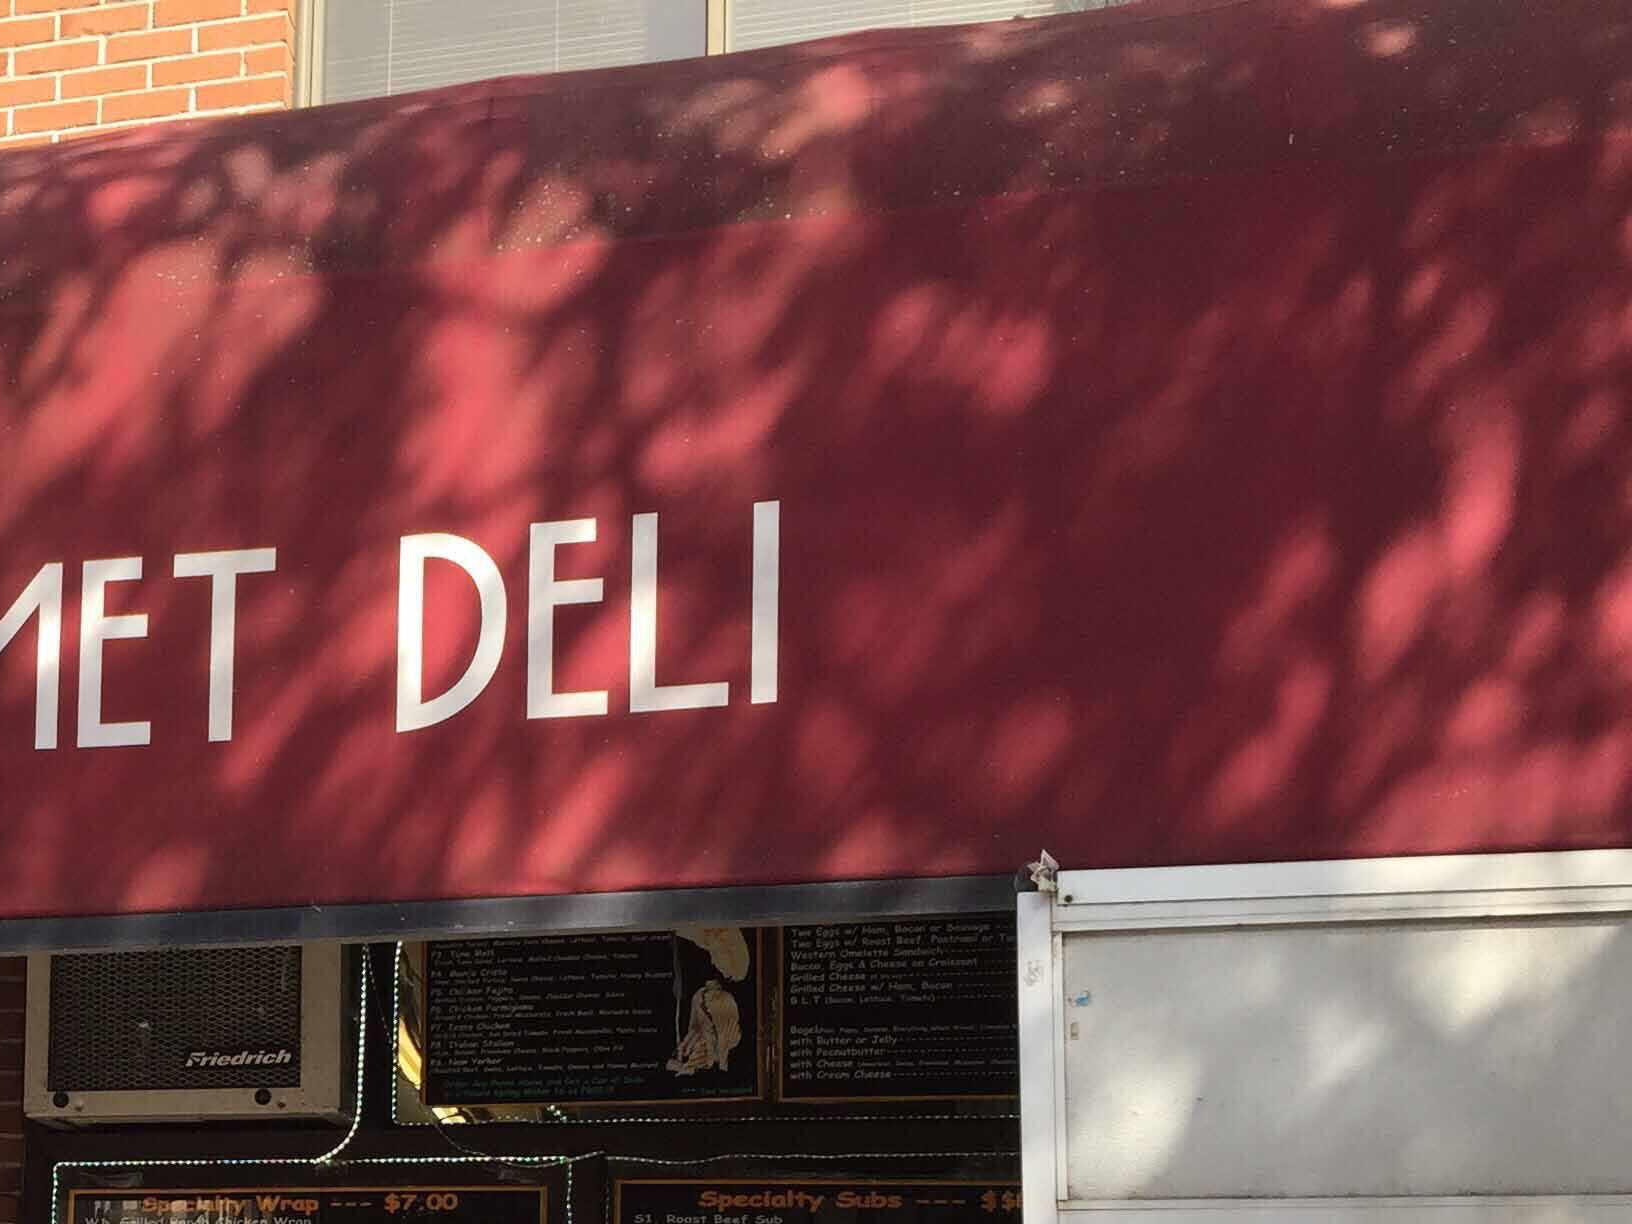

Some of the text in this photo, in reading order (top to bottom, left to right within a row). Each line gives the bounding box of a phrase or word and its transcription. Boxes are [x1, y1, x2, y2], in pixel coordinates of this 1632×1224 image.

[396, 501, 780, 733] DELI
[185, 1049, 291, 1068] Friedrich
[143, 1192, 460, 1216] Specialty Wrap $7.00
[696, 1189, 904, 1213] Specialty Subs
[665, 1214, 708, 1224] Roast
[713, 1214, 747, 1224] Beef
[754, 1214, 783, 1224] Sub
